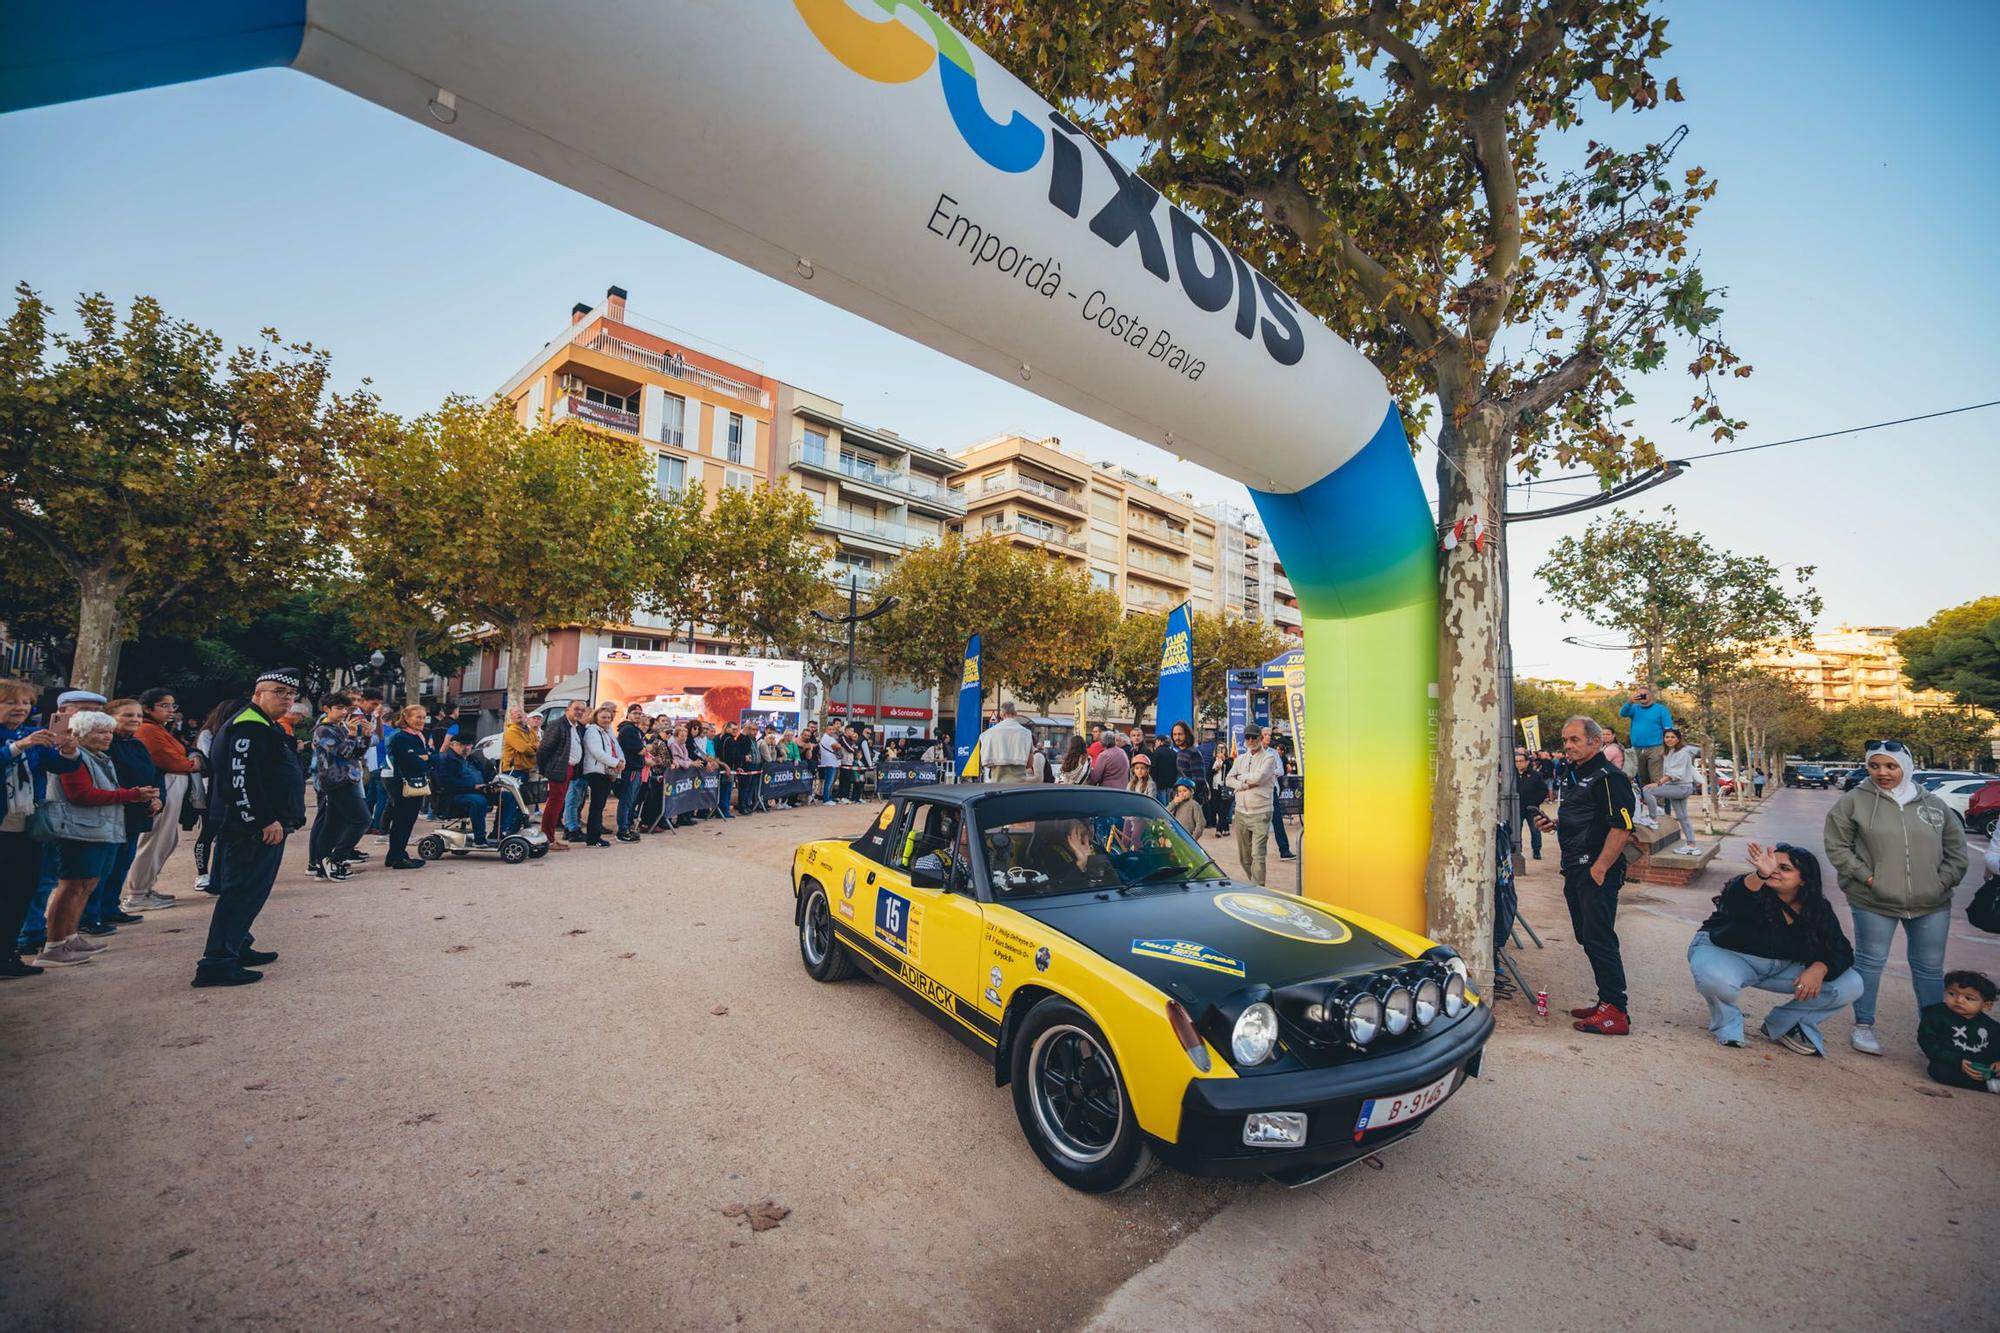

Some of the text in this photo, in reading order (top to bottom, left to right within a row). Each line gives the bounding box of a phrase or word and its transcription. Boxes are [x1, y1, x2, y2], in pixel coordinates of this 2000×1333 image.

[926, 193, 1062, 299] Empordà
[1082, 290, 1149, 350] Costa
[1147, 329, 1206, 382] Brava
[835, 705, 866, 714] Sannder
[896, 709, 924, 718] Santander
[885, 896, 902, 933] 15
[1141, 941, 1172, 951] RALLY
[901, 963, 954, 1012] ADIRACK
[1358, 1118, 1368, 1128] B
